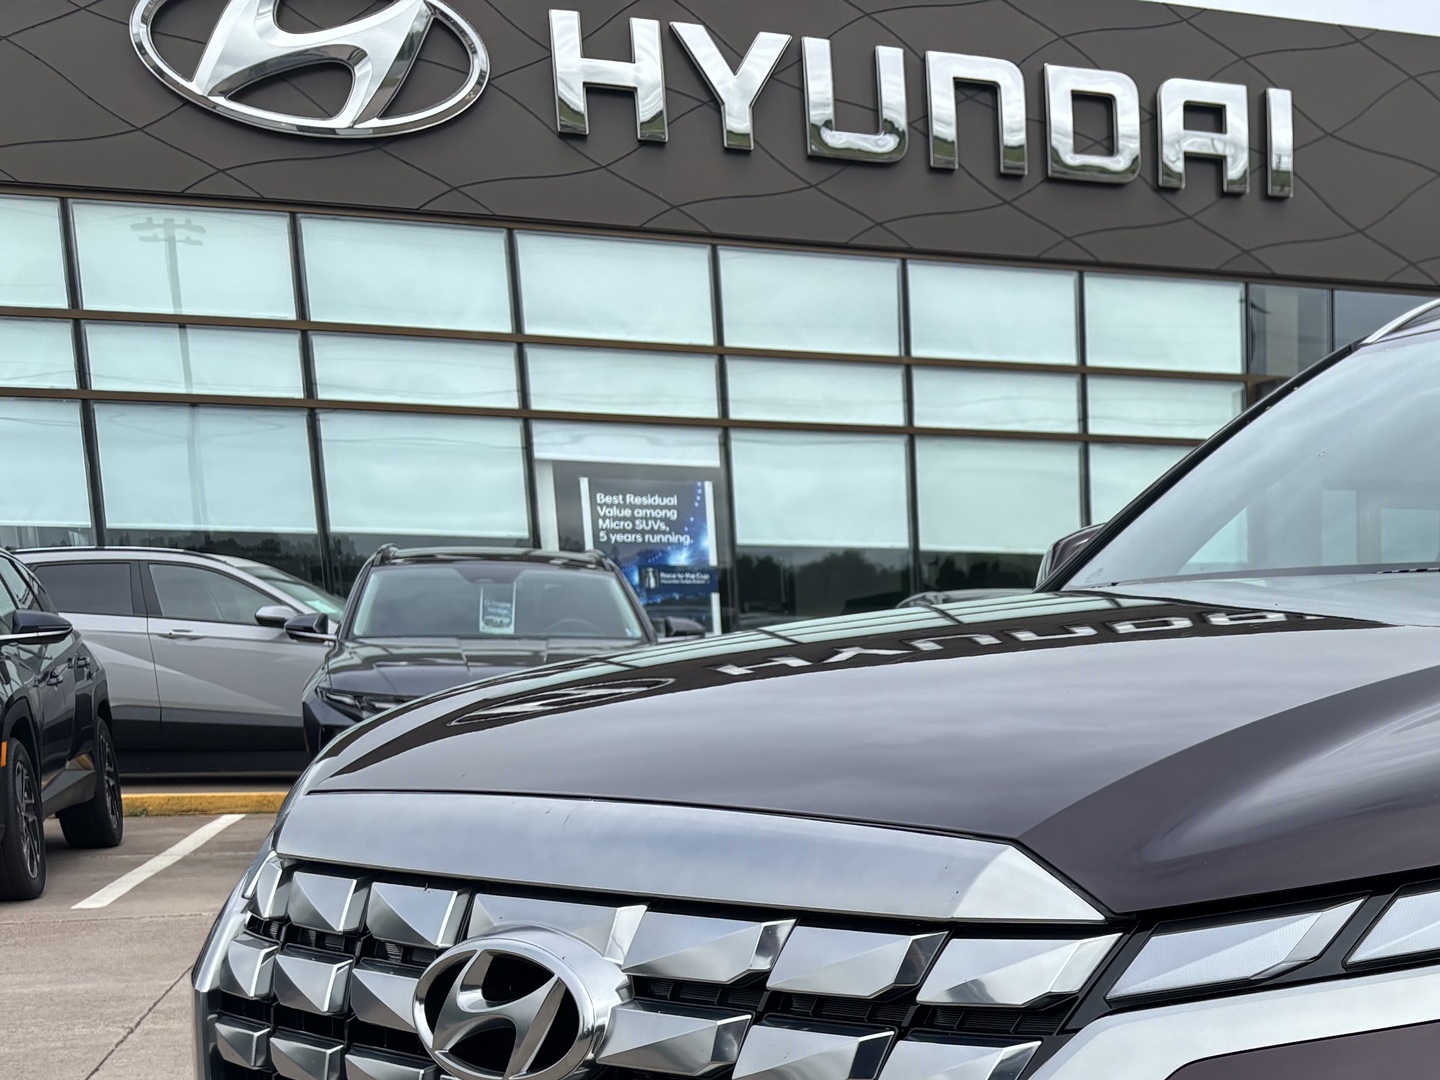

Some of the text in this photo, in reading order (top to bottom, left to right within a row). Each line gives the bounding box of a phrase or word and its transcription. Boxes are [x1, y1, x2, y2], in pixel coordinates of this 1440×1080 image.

[548, 9, 1294, 199] HYUNDAI
[596, 493, 678, 506] Best Residual
[597, 505, 678, 521] Value among
[598, 518, 670, 531] Micro SUVs,
[599, 531, 693, 545] 5 years running.
